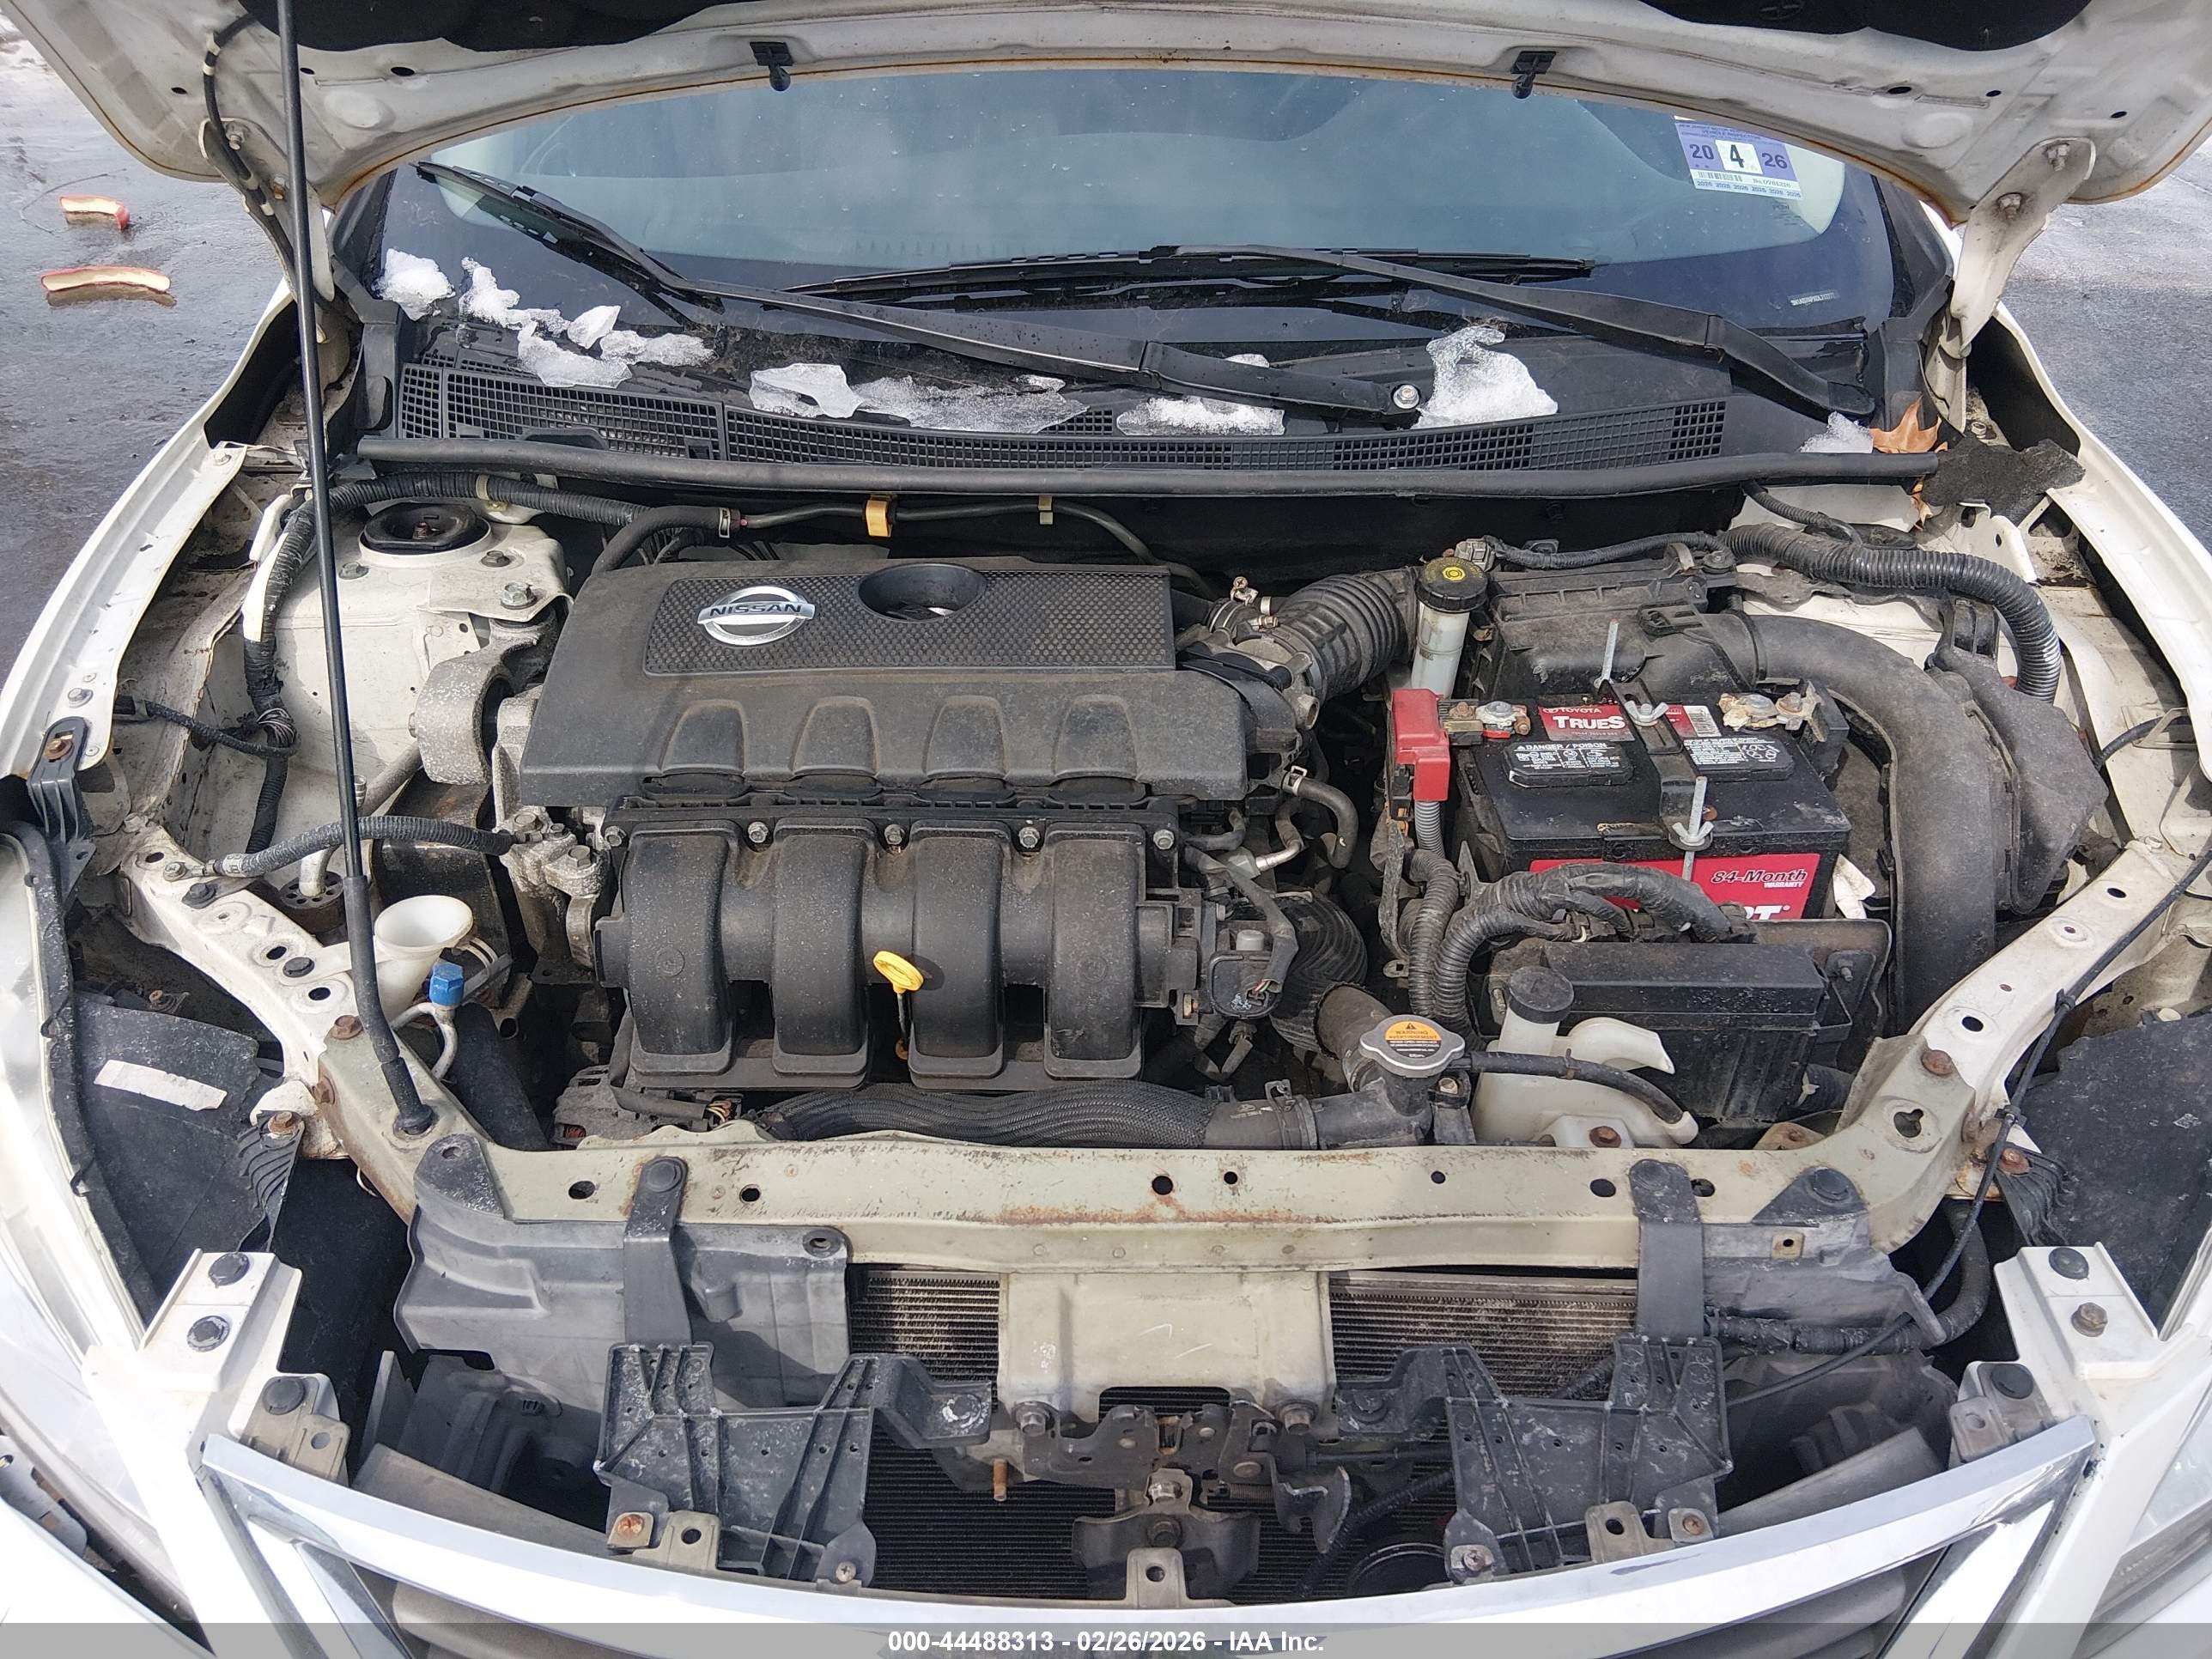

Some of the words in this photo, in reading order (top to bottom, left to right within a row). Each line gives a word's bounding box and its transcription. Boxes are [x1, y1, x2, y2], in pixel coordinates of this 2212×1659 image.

[1689, 143, 1715, 161] 20
[1729, 144, 1744, 168] 4
[1762, 153, 1788, 169] 26
[710, 604, 801, 617] NISSAN
[1553, 715, 1626, 729] TRUES
[1711, 868, 1808, 884] 84-Month
